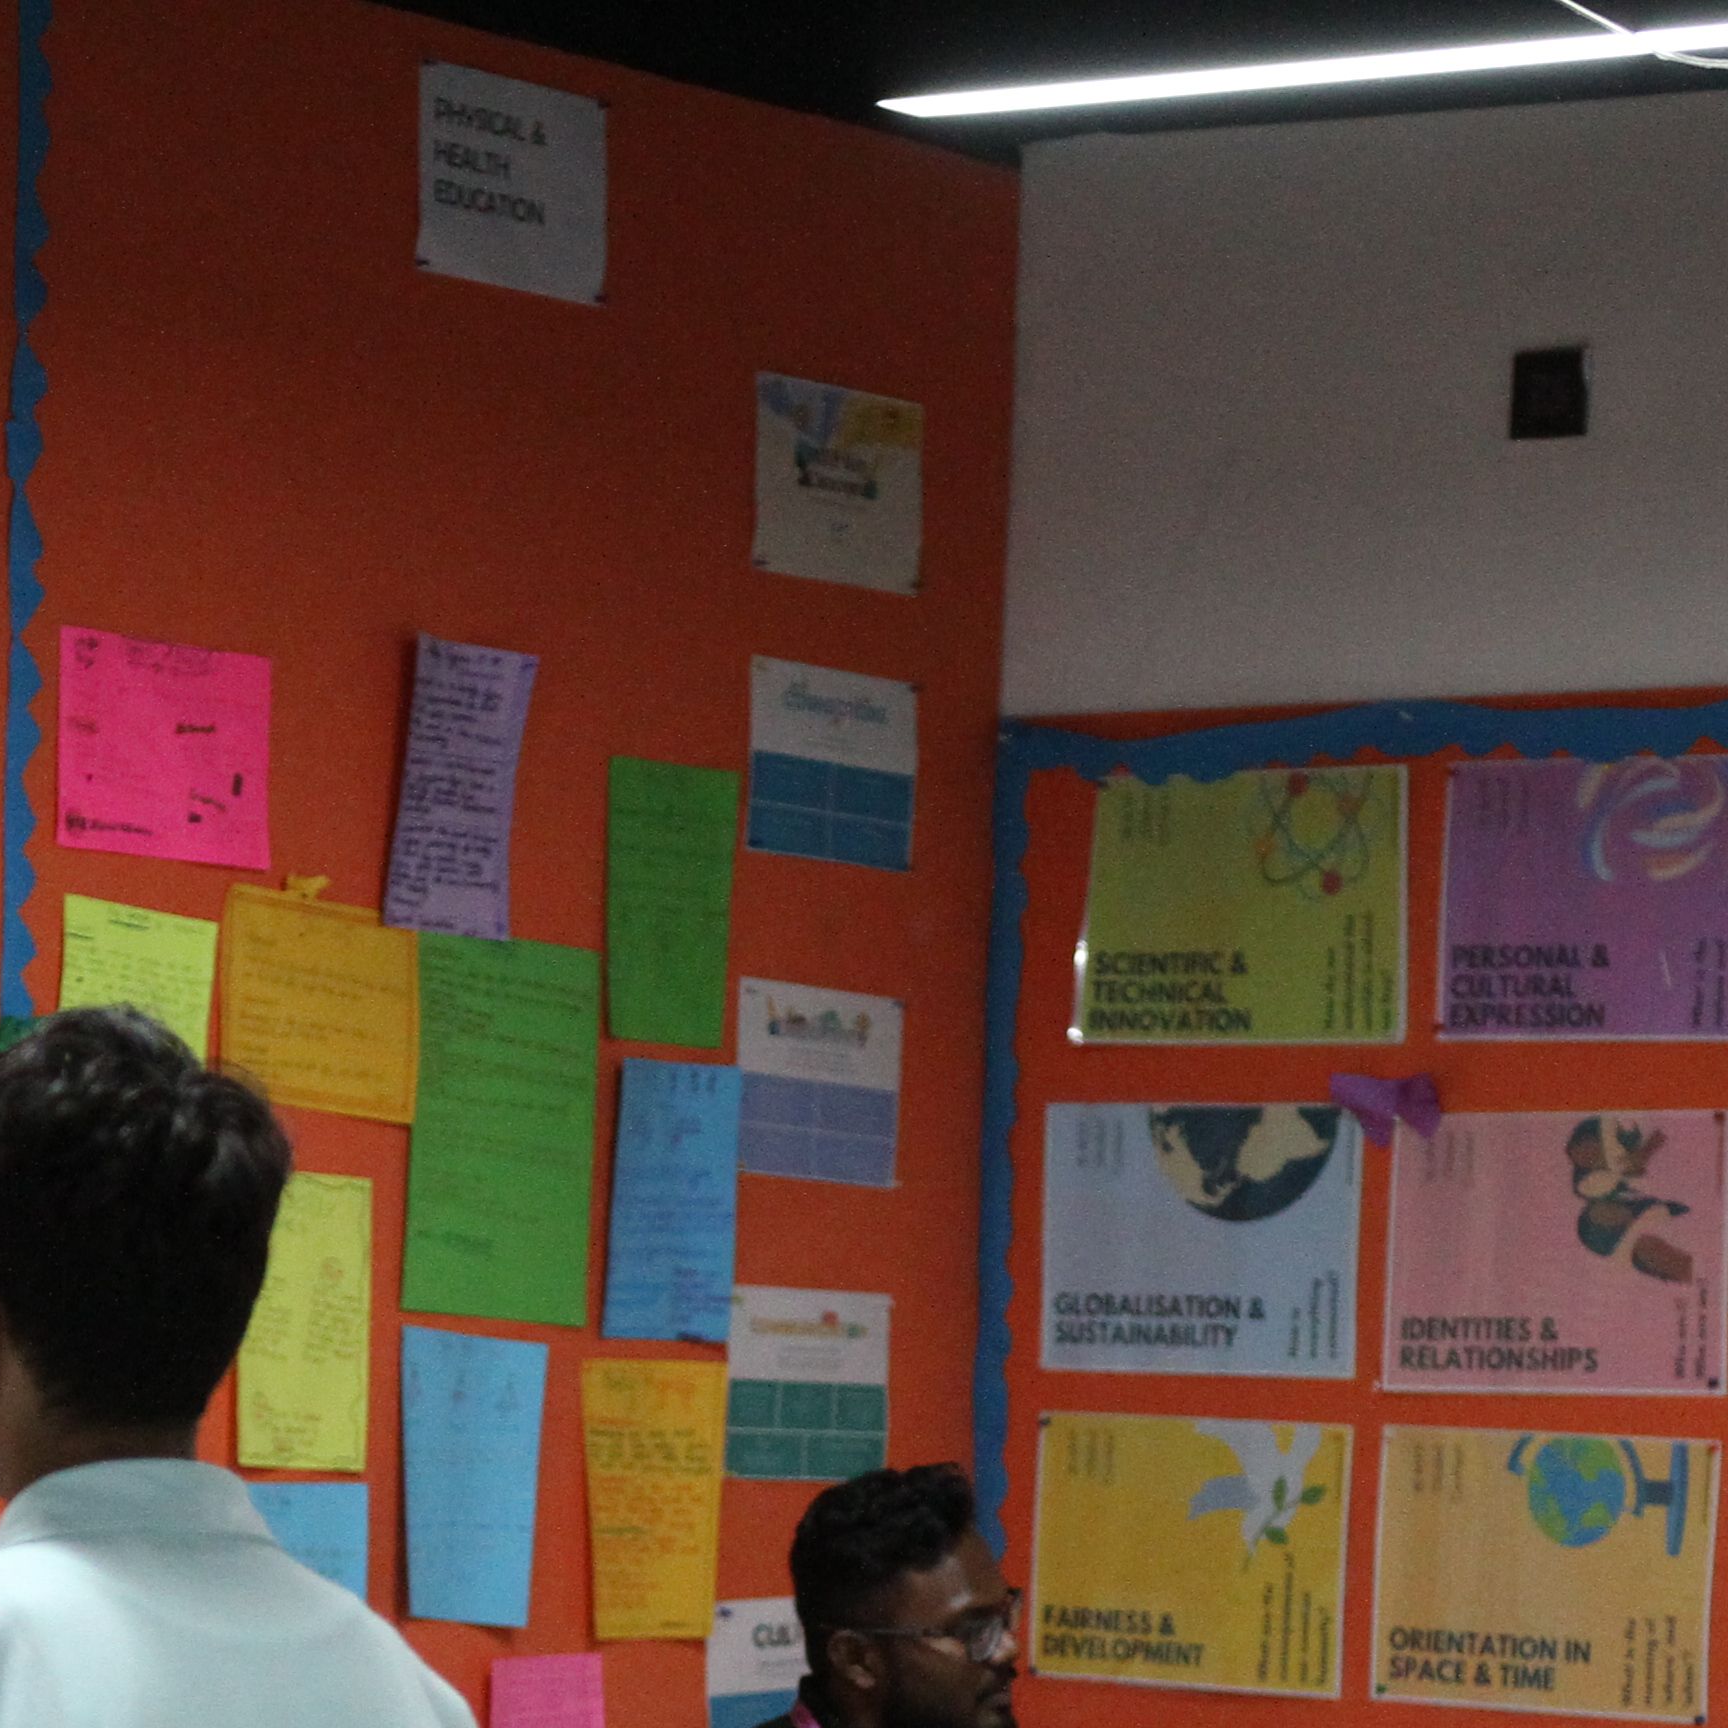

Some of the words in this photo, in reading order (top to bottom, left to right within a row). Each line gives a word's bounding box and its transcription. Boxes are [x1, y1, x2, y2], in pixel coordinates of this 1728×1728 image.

[433, 97, 527, 141] PHYSICAL
[433, 141, 512, 181] HEALTH
[433, 180, 546, 226] EDUCATION
[1094, 951, 1222, 977] SCIENTIFIC
[1230, 952, 1248, 974] &
[1451, 944, 1583, 970] PERSONAL
[1590, 944, 1610, 968] &
[1093, 979, 1227, 1005] TECHNICAL
[1450, 973, 1575, 998] CULTURAL
[1089, 1007, 1253, 1033] INNOVATION
[1449, 1002, 1606, 1029] EXPRESSION
[1054, 1290, 1242, 1320] GLOBALISATION
[1246, 1297, 1267, 1321] &
[1054, 1318, 1239, 1348] SUSTAINABILITY
[1400, 1315, 1532, 1342] IDENTITIES
[1539, 1316, 1560, 1341] &
[1399, 1344, 1599, 1374] RELATIONSHIPS
[1042, 1604, 1152, 1634] FAIRNESS
[1158, 1614, 1176, 1637] &
[1042, 1632, 1206, 1668] DEVELOPMENT
[1389, 1626, 1558, 1662] ORIENTATION
[1564, 1638, 1592, 1664] IN
[1388, 1655, 1467, 1686] SPACE
[1474, 1663, 1492, 1687] &
[1499, 1664, 1556, 1692] TIME
